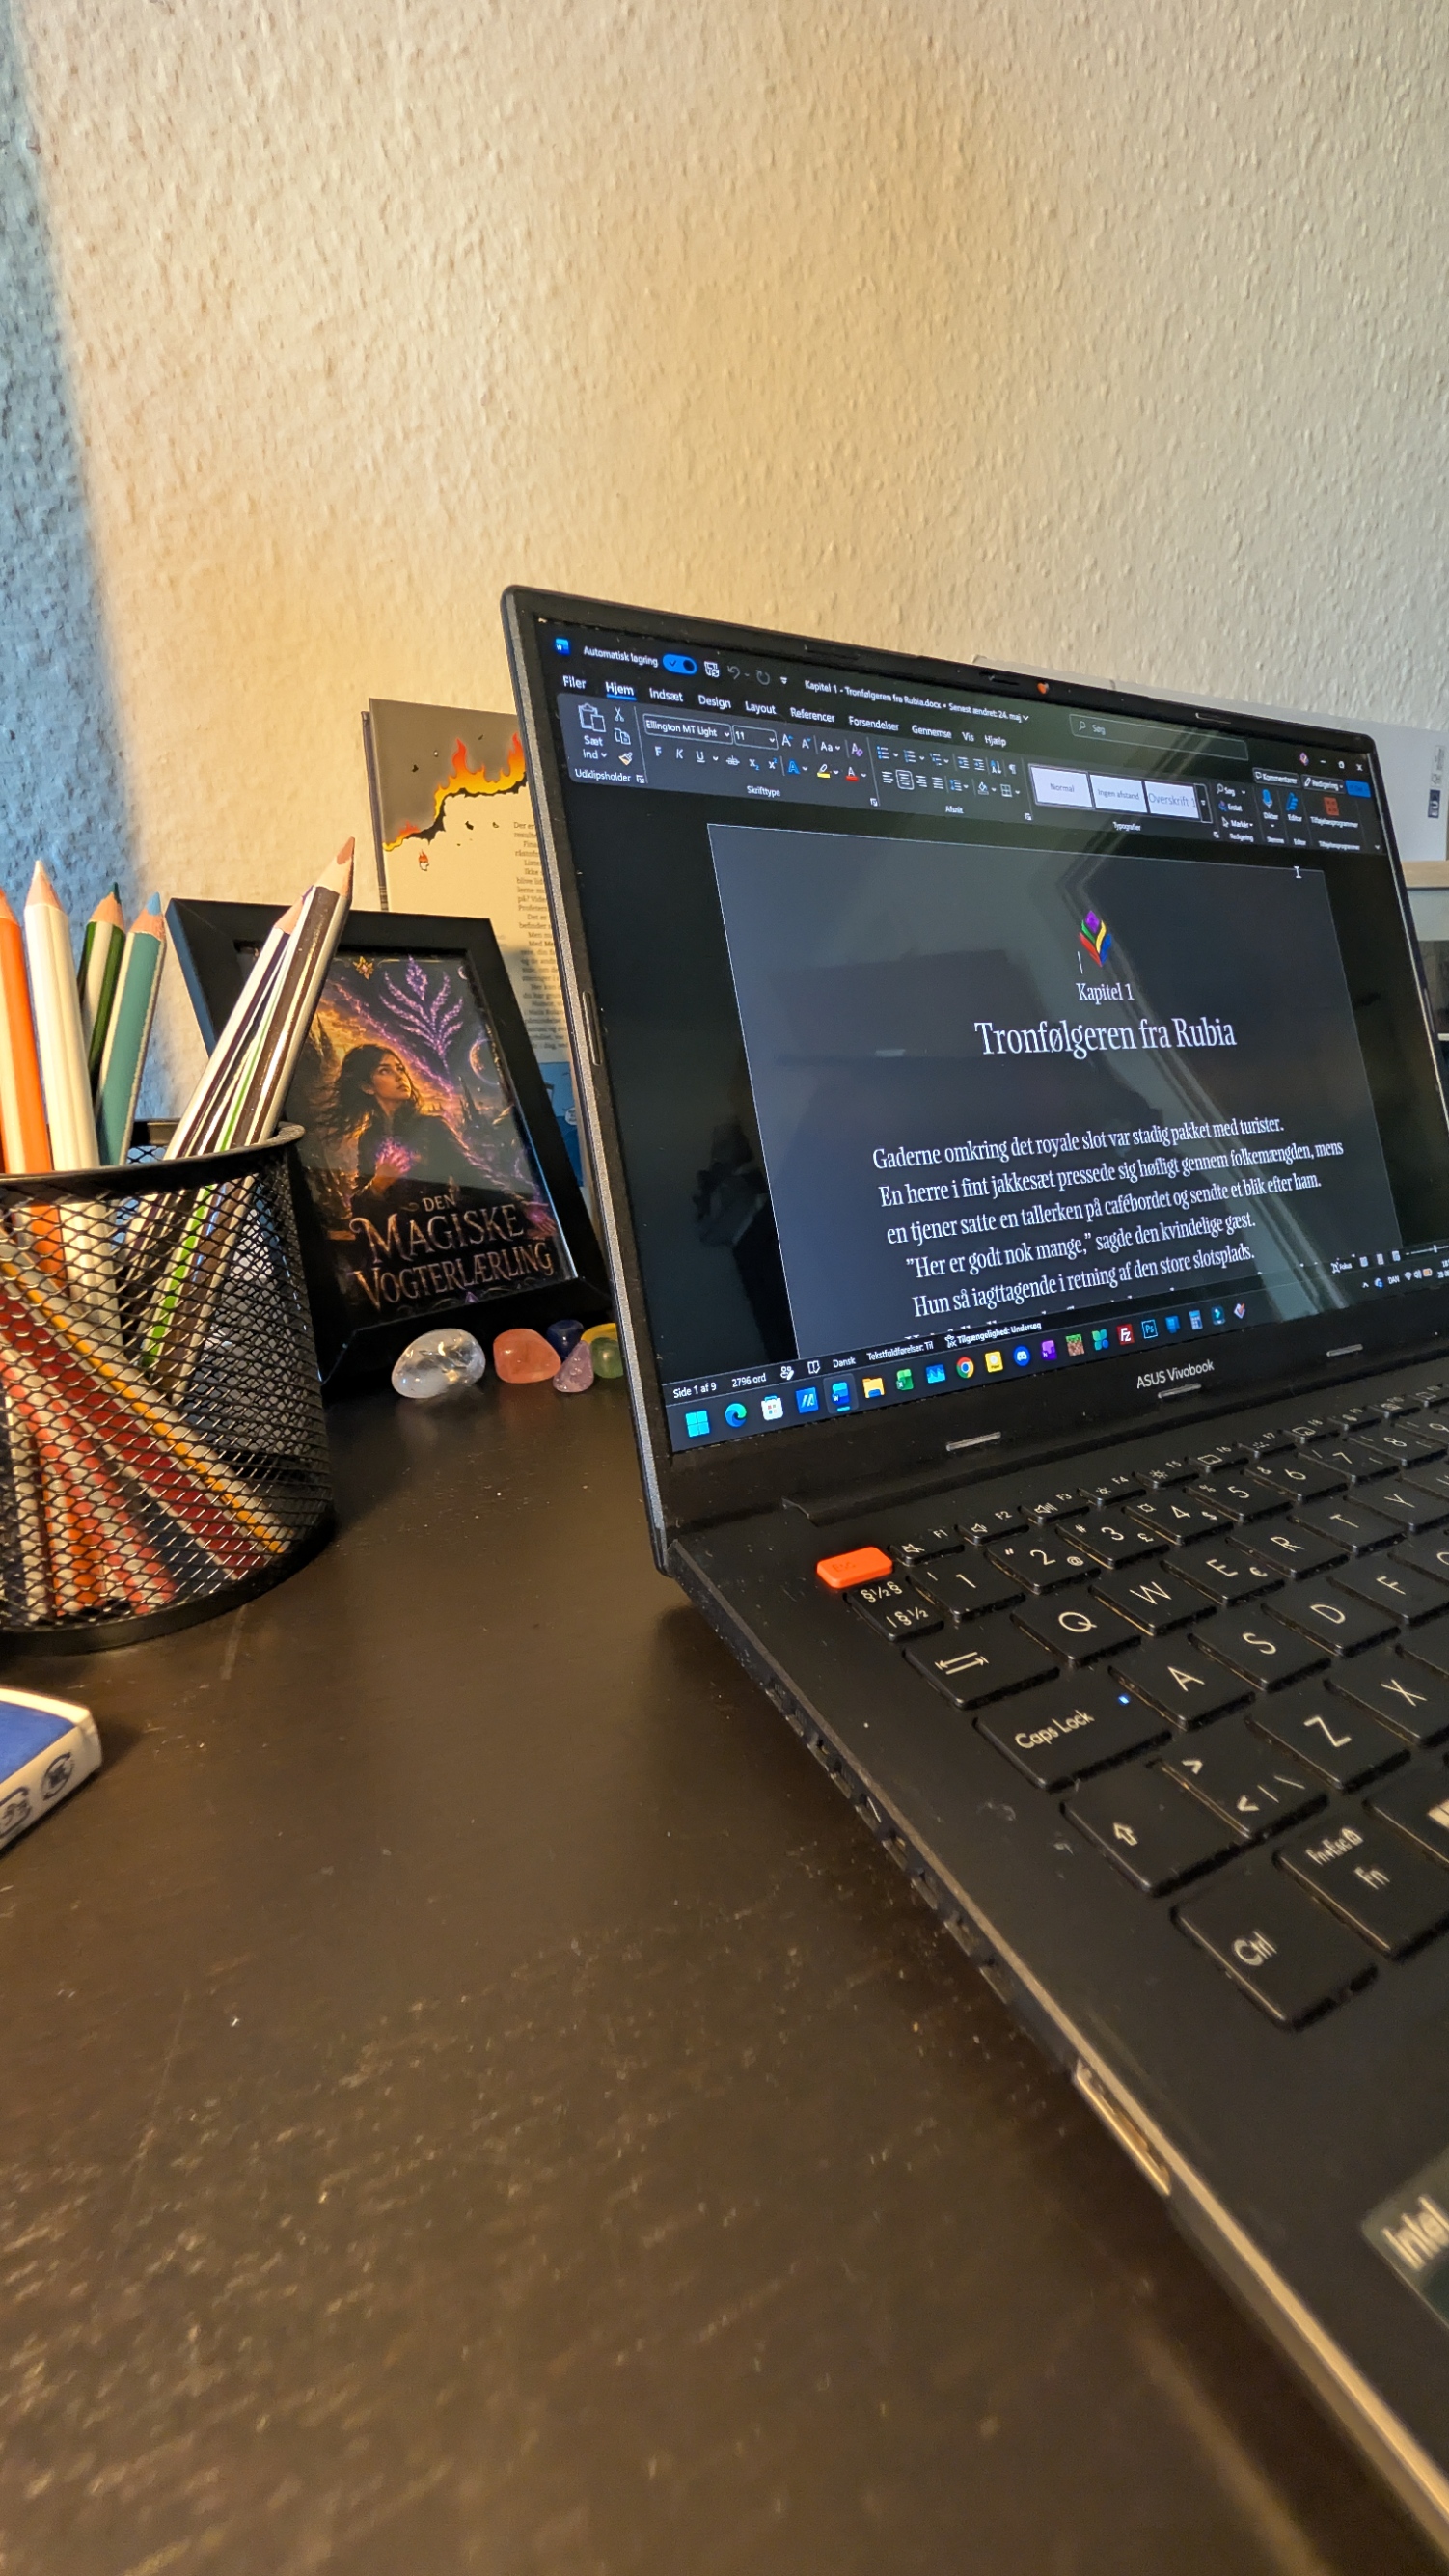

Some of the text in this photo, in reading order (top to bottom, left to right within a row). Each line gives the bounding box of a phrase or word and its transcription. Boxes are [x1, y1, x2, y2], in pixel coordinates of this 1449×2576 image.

[583, 645, 659, 669] Automatisk lagring
[562, 675, 1007, 748] Filer Hjem Indsæt Design Layout Referencer Forsendelser Gennemse Vis Hjælp
[805, 680, 832, 694] Kapitel
[845, 686, 891, 702] Tronfølgeren
[892, 693, 903, 703] fra
[904, 695, 942, 710] Rubia.docx
[948, 702, 971, 715] Senest
[1009, 713, 1022, 724] maj
[645, 720, 718, 738] Ellington MT Light
[735, 729, 745, 741] 11
[1092, 723, 1106, 736] Søg
[584, 735, 603, 748] Sæt
[574, 768, 631, 783] Udklipsholder
[747, 785, 780, 798] Skrifttype
[1049, 782, 1075, 794] Normal
[1097, 787, 1140, 801] Ingen afstand
[1148, 792, 1189, 808] Overskrift
[1076, 982, 1135, 1005] Kapitel 1
[974, 1017, 1237, 1059] Tronfølgeren fra Rubia
[872, 1117, 1284, 1169] Gaderne omkring det royale slot var stadig pakket med turister.
[878, 1141, 1344, 1208] En herre i fint jakkesæt pressede sig høfligt gennem folkemængden, mens
[422, 1194, 456, 1213] DEN
[887, 1172, 1322, 1247] en tjener satte en tallerken på cafébordet og sendte et blik efter ham.
[349, 1205, 525, 1264] MAGISKE
[949, 1255, 967, 1273] er
[968, 1247, 1004, 1275] godt
[1004, 1242, 1034, 1266] nok
[1096, 1227, 1133, 1254] sagde
[1135, 1224, 1159, 1246] den
[1159, 1216, 1223, 1241] kvindelige
[1225, 1211, 1256, 1236] gæst.
[352, 1242, 555, 1312] VOGTERLÆRLING
[912, 1243, 1255, 1318] Hun så iagttagende i retning af den store slotsplads.
[1387, 1274, 1400, 1285] DAN
[957, 1320, 1042, 1345] Tilgængelighed: Undersøg
[866, 1340, 934, 1361] Tekstfuldførelser: Til
[833, 1356, 856, 1368] Dansk
[1136, 1358, 1215, 1390] ASUS Vivobook
[673, 1386, 693, 1400] Side
[699, 1383, 710, 1394] af
[711, 1381, 718, 1391] 9
[731, 1375, 752, 1388] 2796
[752, 1373, 767, 1384] ord
[1382, 1437, 1408, 1448] 8
[1332, 1451, 1353, 1465] 7
[1112, 1475, 1129, 1486] F4
[1284, 1468, 1307, 1481] 6
[1056, 1492, 1073, 1501] F3
[1227, 1485, 1250, 1499] 5
[1383, 1493, 1416, 1509] Y
[995, 1510, 1013, 1521] F2
[1170, 1505, 1192, 1520] 4
[1329, 1513, 1360, 1529] T
[933, 1528, 949, 1539] F1
[1101, 1526, 1125, 1542] 3
[1270, 1535, 1305, 1553] R
[1029, 1548, 1056, 1566] 2
[1206, 1557, 1239, 1578] E
[955, 1573, 977, 1589] 1
[1376, 1575, 1407, 1596] F
[1129, 1581, 1172, 1605] W
[1058, 1610, 1098, 1633] Q
[1309, 1603, 1347, 1625] D
[1242, 1632, 1278, 1656] S
[1167, 1665, 1206, 1693] A
[1380, 1679, 1429, 1708] X
[1014, 1709, 1095, 1750] Caps Lock
[1302, 1714, 1353, 1748] Z
[1353, 1867, 1390, 1890] Fn
[1233, 1930, 1278, 1967] Ctrl
